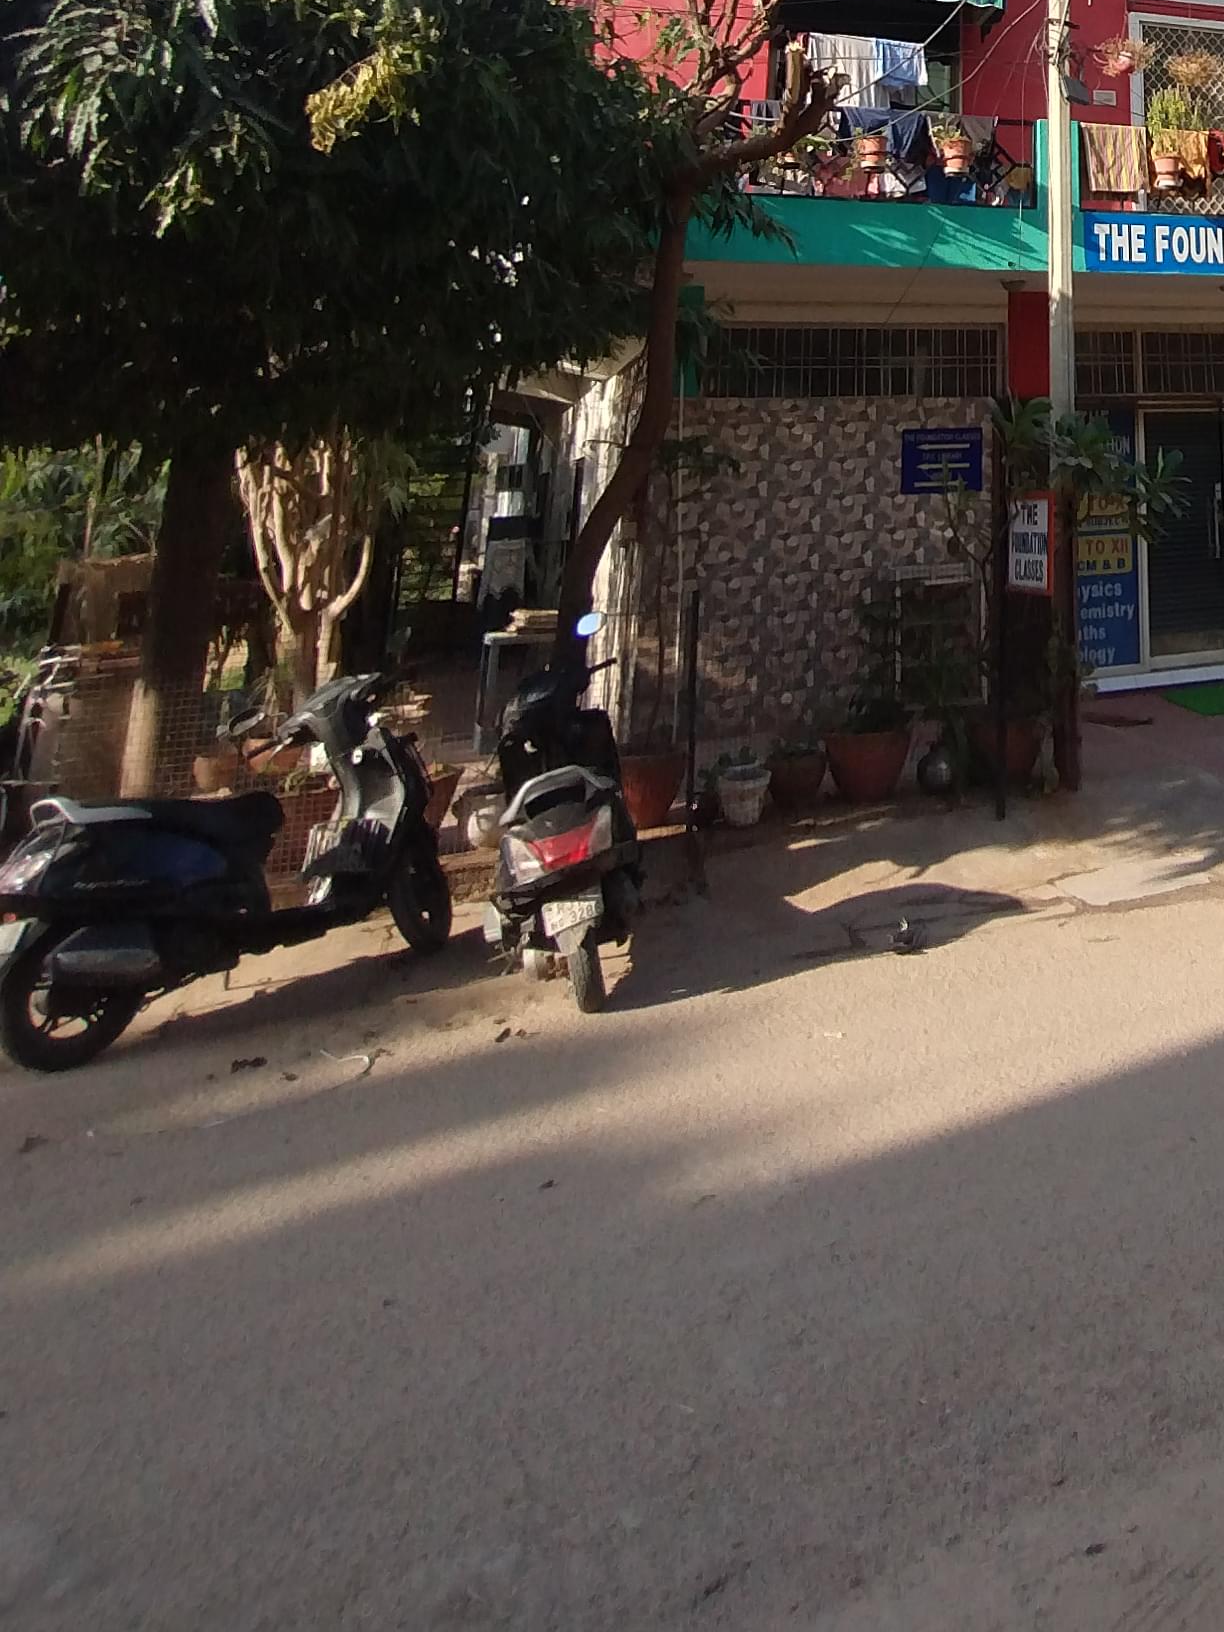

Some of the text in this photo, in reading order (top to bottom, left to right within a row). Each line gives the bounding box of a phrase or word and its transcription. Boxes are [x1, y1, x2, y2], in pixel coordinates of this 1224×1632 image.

[1093, 223, 1147, 262] THE
[1021, 504, 1038, 526] THE
[1012, 532, 1048, 556] FOUNDATION
[1086, 539, 1105, 556] TO
[1112, 537, 1128, 554] XII
[1014, 559, 1044, 583] CLASSES
[1077, 559, 1096, 571] CM
[1077, 580, 1122, 603] ysics
[1080, 602, 1135, 621] emistry
